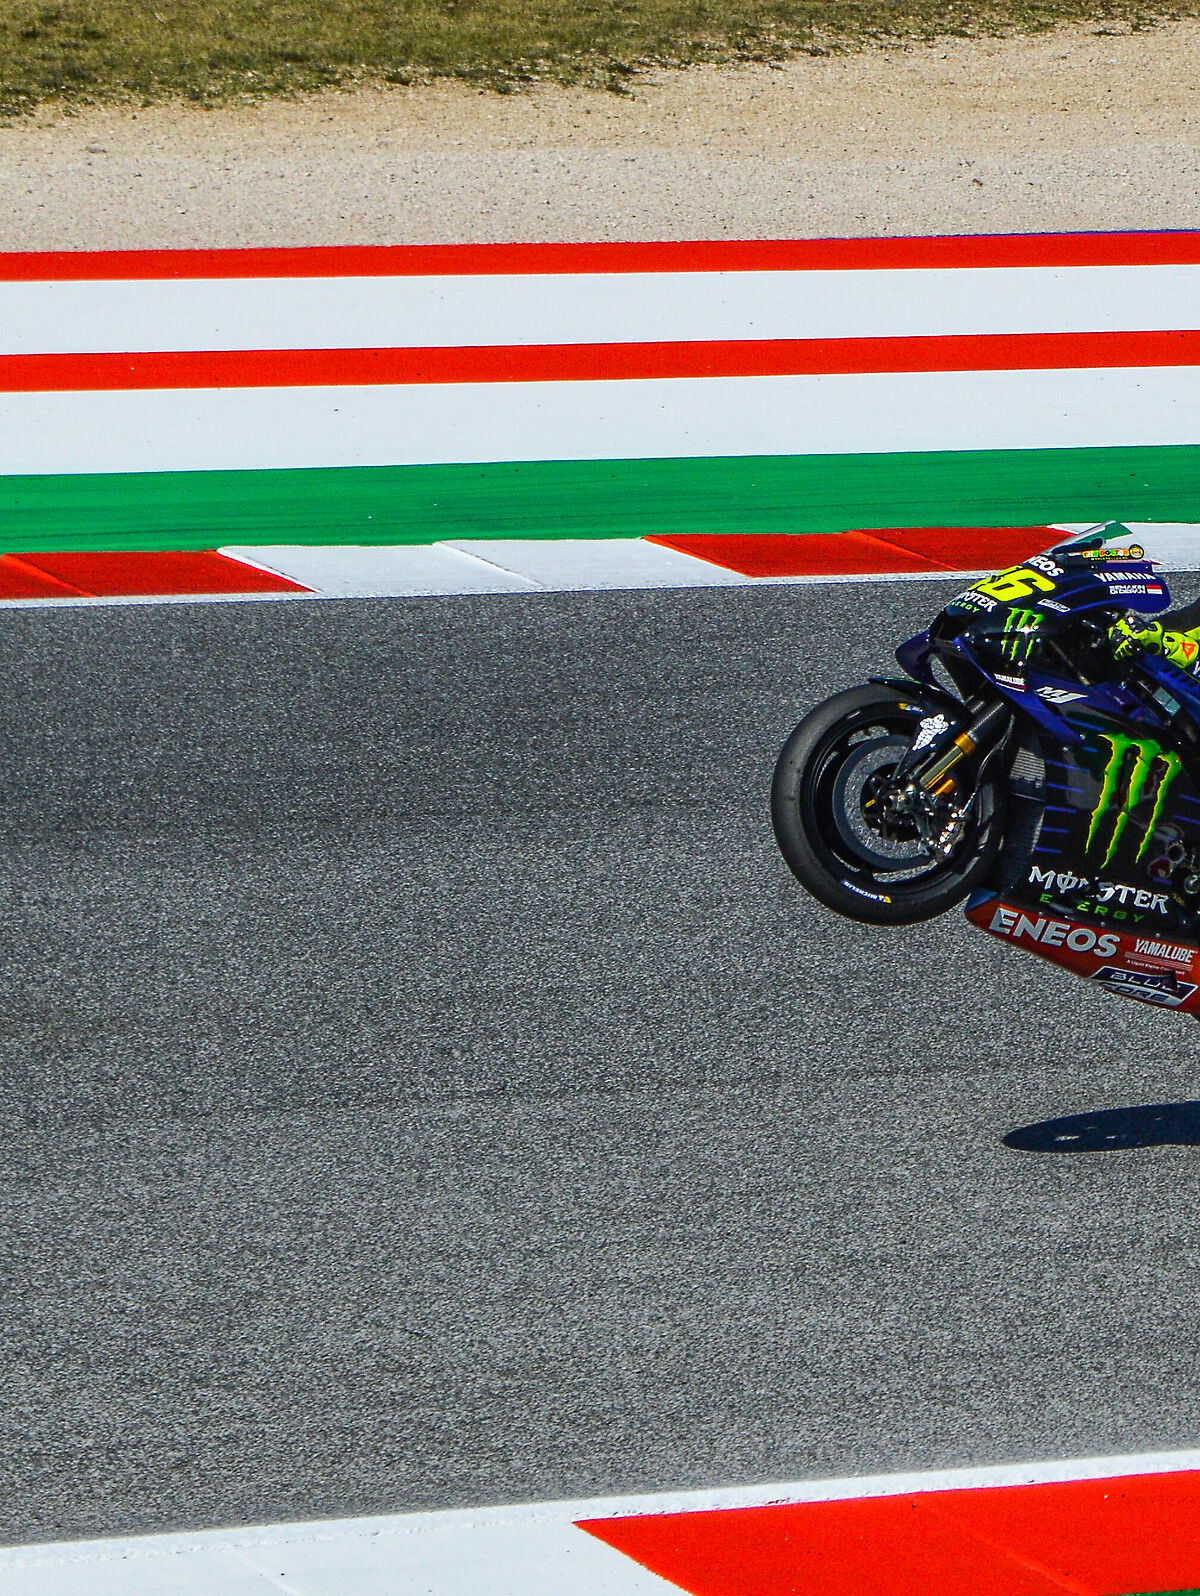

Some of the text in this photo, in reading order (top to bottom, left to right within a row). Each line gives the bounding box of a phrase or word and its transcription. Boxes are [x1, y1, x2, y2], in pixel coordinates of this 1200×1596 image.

[1093, 572, 1157, 582] YAMAHA
[1040, 893, 1145, 923] EERGY
[988, 907, 1121, 958] ENEOS
[1134, 939, 1195, 963] YAMALUBE
